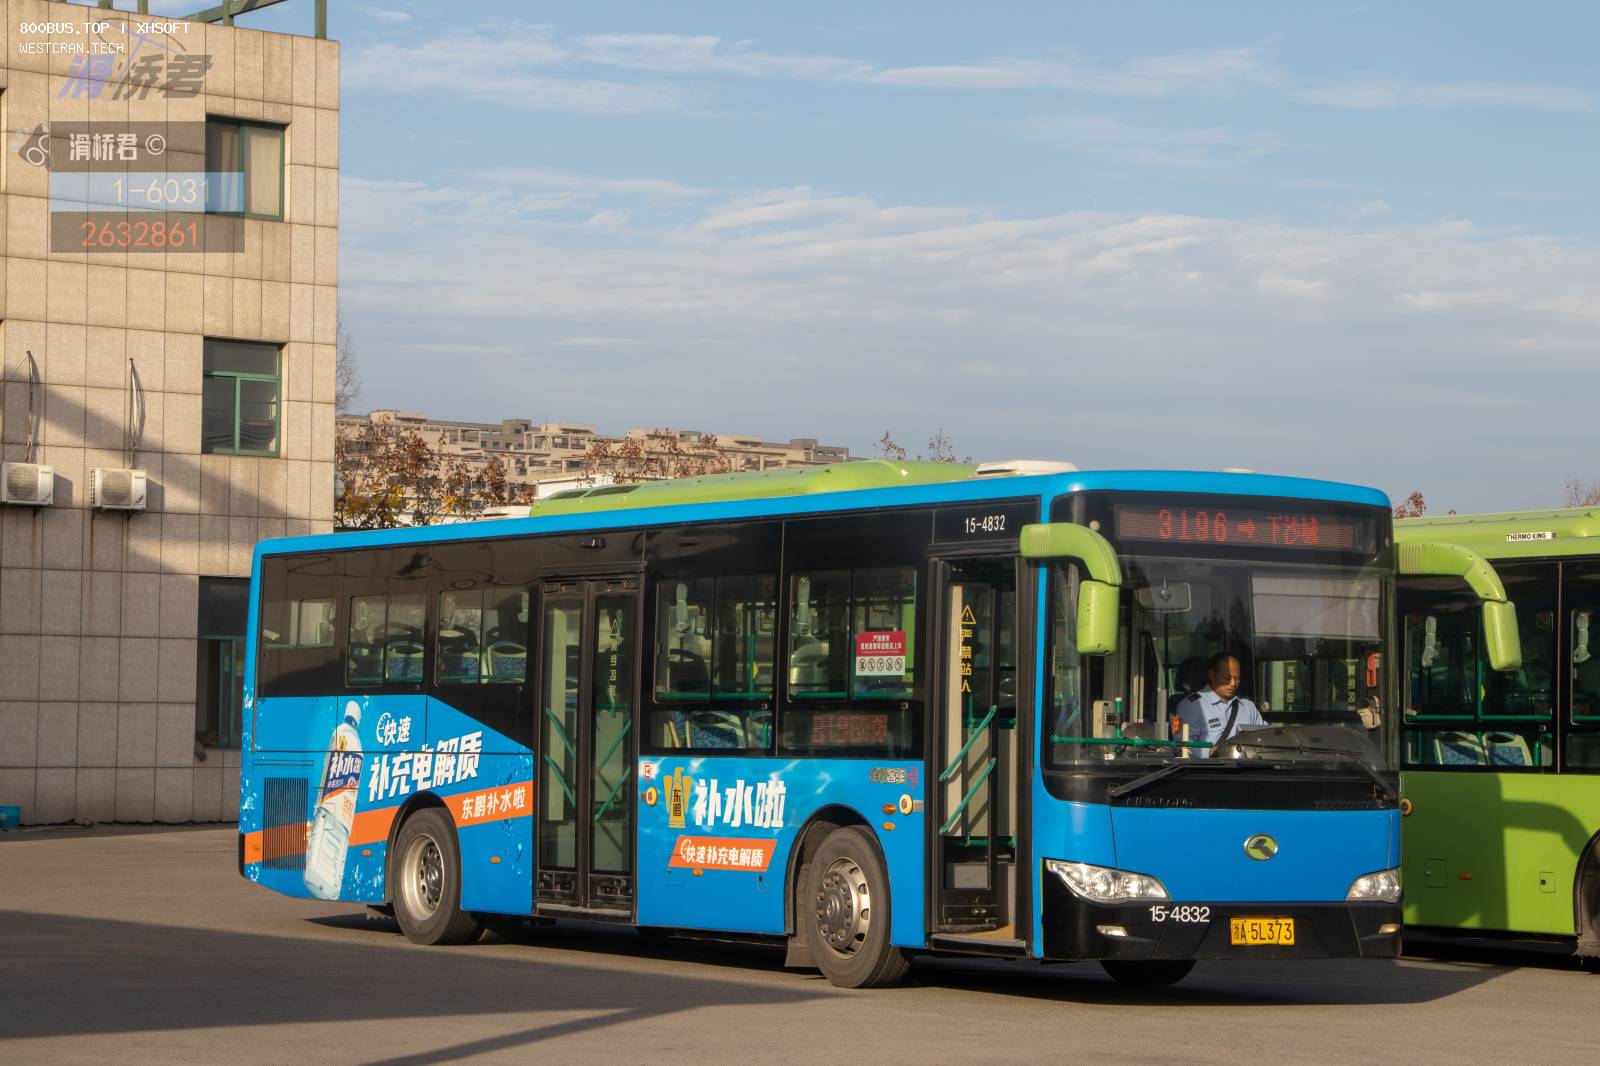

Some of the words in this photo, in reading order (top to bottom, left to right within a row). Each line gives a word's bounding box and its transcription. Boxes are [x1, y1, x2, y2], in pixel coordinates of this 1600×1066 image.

[964, 514, 1006, 534] 15-4832
[1507, 533, 1531, 541] THERMO
[384, 716, 412, 746] 快速
[368, 730, 483, 802] 补充电解质
[461, 786, 526, 820] 东鹏补水啦
[692, 778, 787, 828] 补水啦
[685, 845, 764, 867] 快速补充电解质
[1149, 905, 1210, 922] 15-4832
